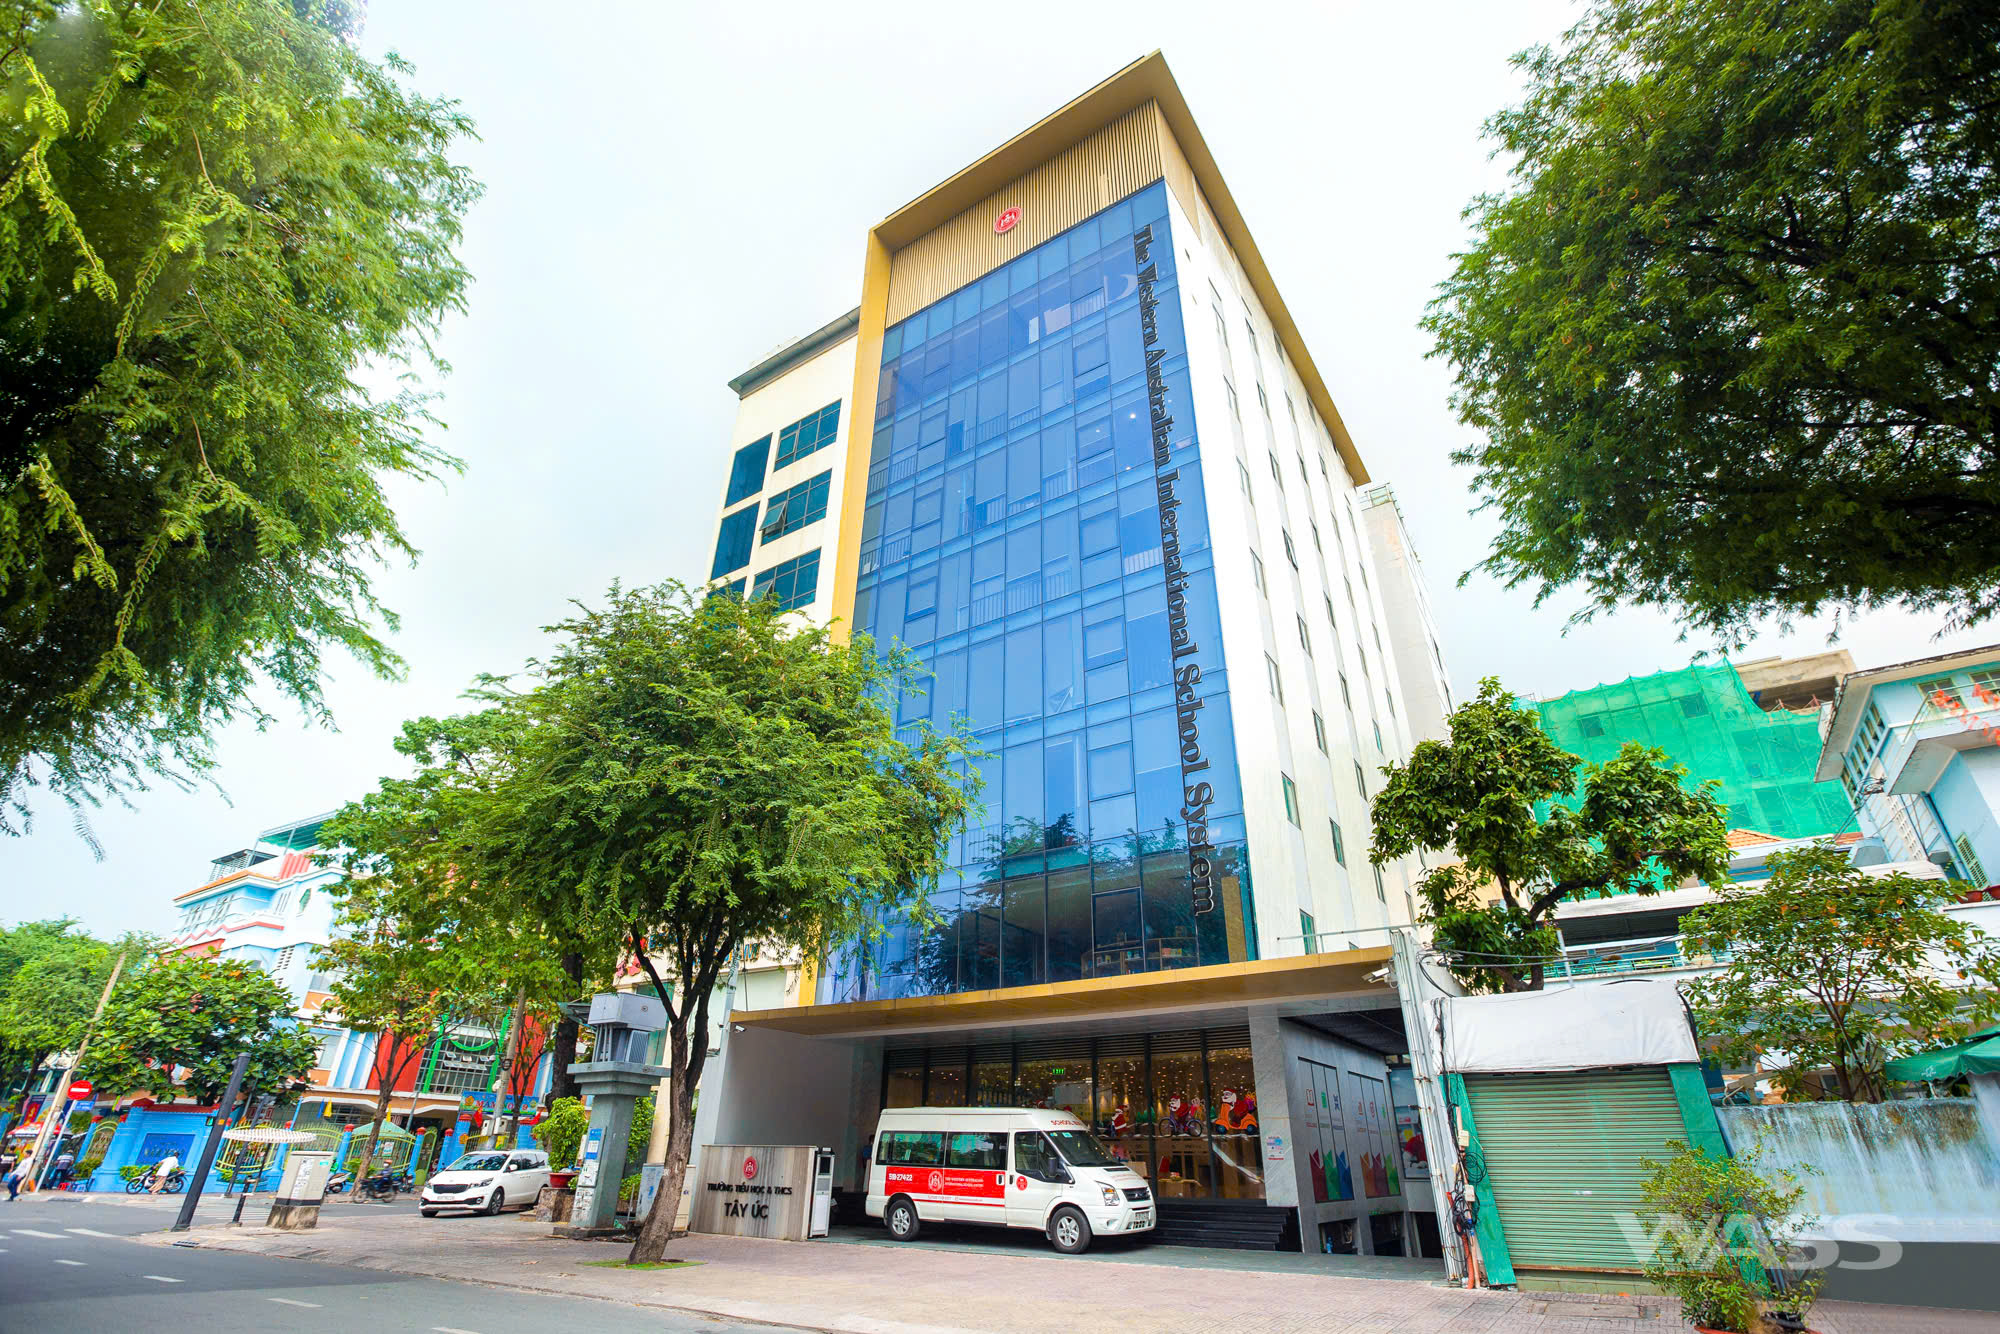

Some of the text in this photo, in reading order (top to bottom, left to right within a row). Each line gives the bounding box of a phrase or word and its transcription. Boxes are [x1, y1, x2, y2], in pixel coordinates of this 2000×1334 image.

[1134, 223, 1215, 917] The Western Australian International School System
[767, 1186, 772, 1194] &
[774, 1186, 793, 1195] THCS
[724, 1199, 769, 1219] TÂY ÚC
